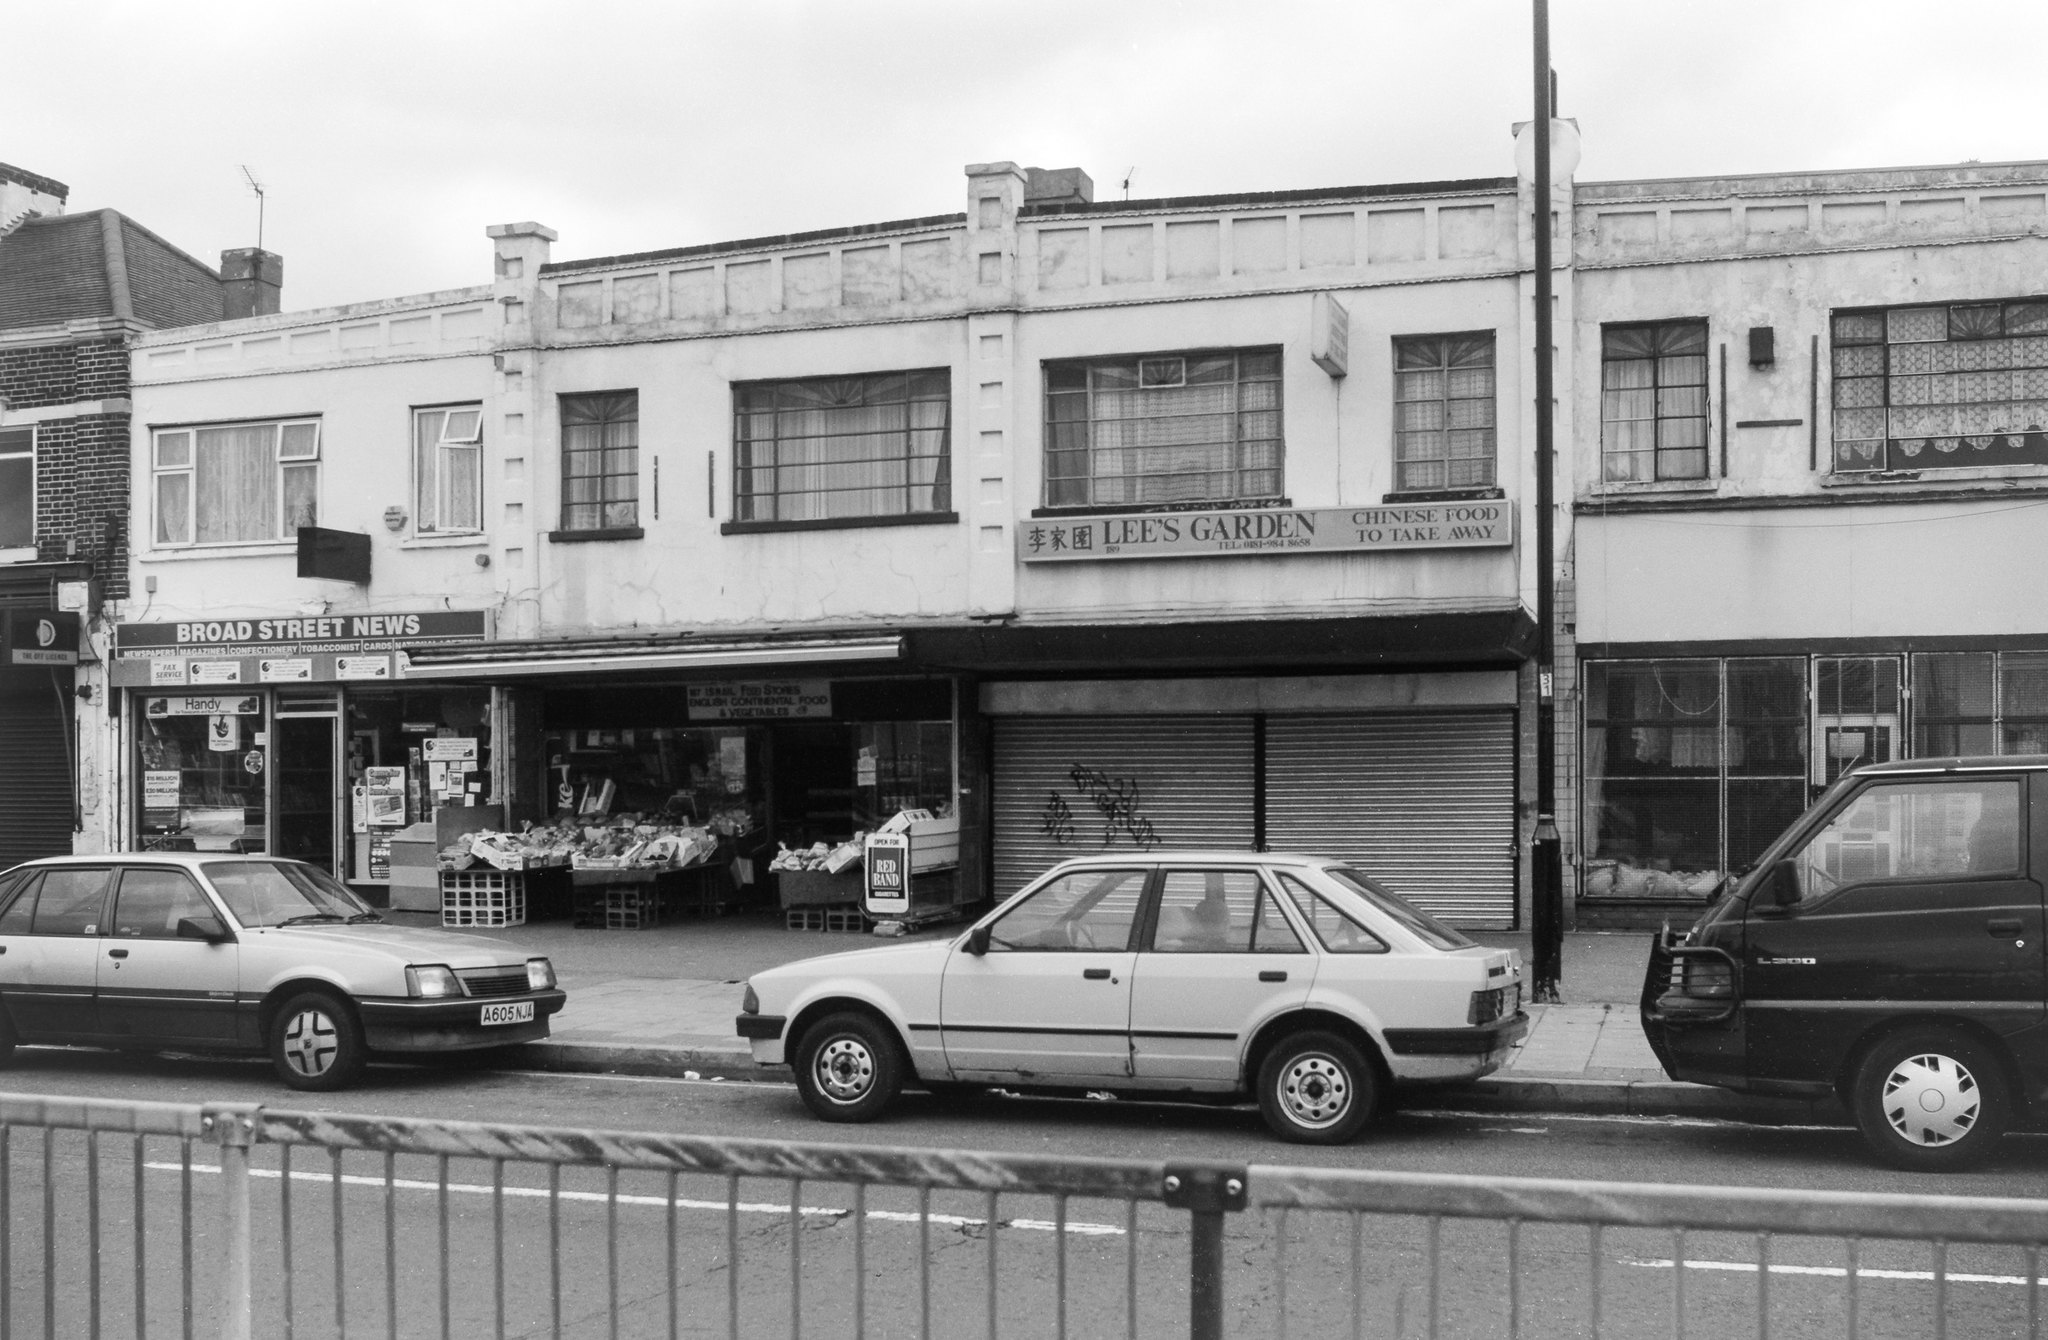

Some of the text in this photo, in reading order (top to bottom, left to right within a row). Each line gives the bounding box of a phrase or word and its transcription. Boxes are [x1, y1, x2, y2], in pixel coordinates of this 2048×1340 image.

[1352, 506, 1499, 525] CHINESE FOOD
[1102, 512, 1317, 545] LEE'S GARDEN
[1356, 525, 1496, 543] TO TAKE AWAY
[177, 614, 421, 643] BROAD STREET NEWS
[124, 648, 176, 658] NEWSPAPERS
[179, 647, 226, 657] MAGAZINES
[229, 644, 298, 655] CONFECTIONERY
[301, 642, 360, 653] TOBACCONIST
[364, 641, 392, 651] CARDS
[185, 697, 221, 712] Handy
[876, 859, 896, 873] RED
[873, 872, 899, 887] BAND
[1757, 957, 1816, 965] L300
[483, 1006, 514, 1022] A605
